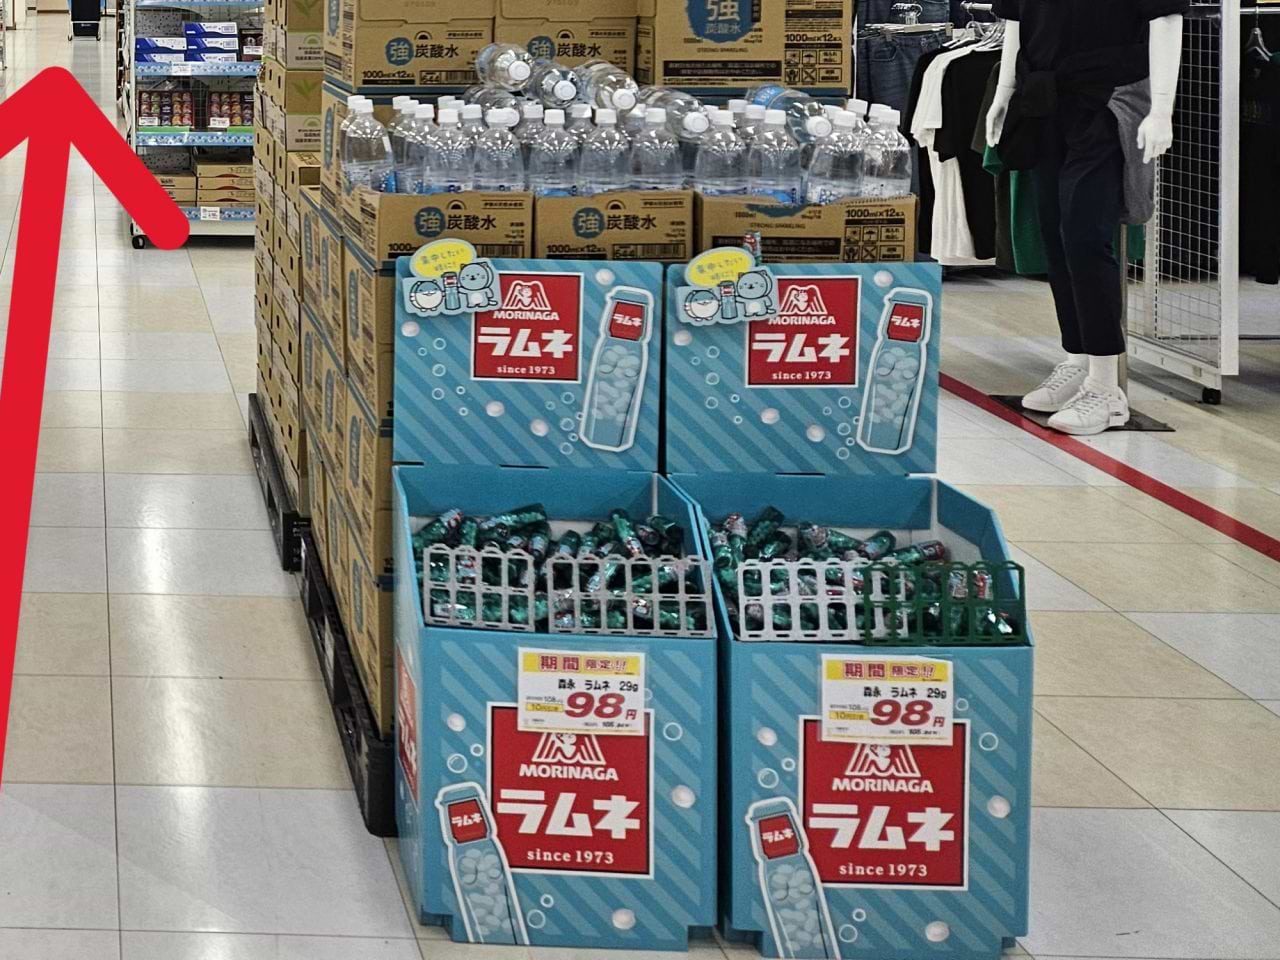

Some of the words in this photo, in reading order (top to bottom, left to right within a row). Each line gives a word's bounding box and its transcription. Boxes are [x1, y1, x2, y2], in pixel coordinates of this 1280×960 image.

[493, 310, 559, 321] MORINAGA
[613, 313, 642, 327] ラムネ
[768, 314, 836, 325] MORINAGA
[890, 315, 920, 328] ラムネ
[477, 327, 573, 358] ラムネ
[752, 333, 850, 363] ラムネ
[497, 365, 526, 374] since
[529, 365, 555, 374] 1973
[772, 371, 802, 380] since
[805, 371, 831, 380] 1973
[584, 680, 610, 691] ラムネ
[619, 681, 638, 692] 29g
[891, 687, 917, 697] ラムネ
[927, 688, 947, 699] 29g
[565, 692, 637, 720] 98円
[870, 699, 945, 727] 98円
[519, 764, 619, 781] MORINAGA
[832, 777, 933, 793] MORINAGA
[451, 812, 483, 827] ラムネ
[497, 789, 640, 840] ラムネ
[809, 803, 954, 851] ラムネ
[762, 827, 794, 843] ラムネ
[527, 848, 570, 862] since
[575, 850, 614, 864] 1973
[839, 862, 884, 875] since
[888, 864, 928, 877] 1973
